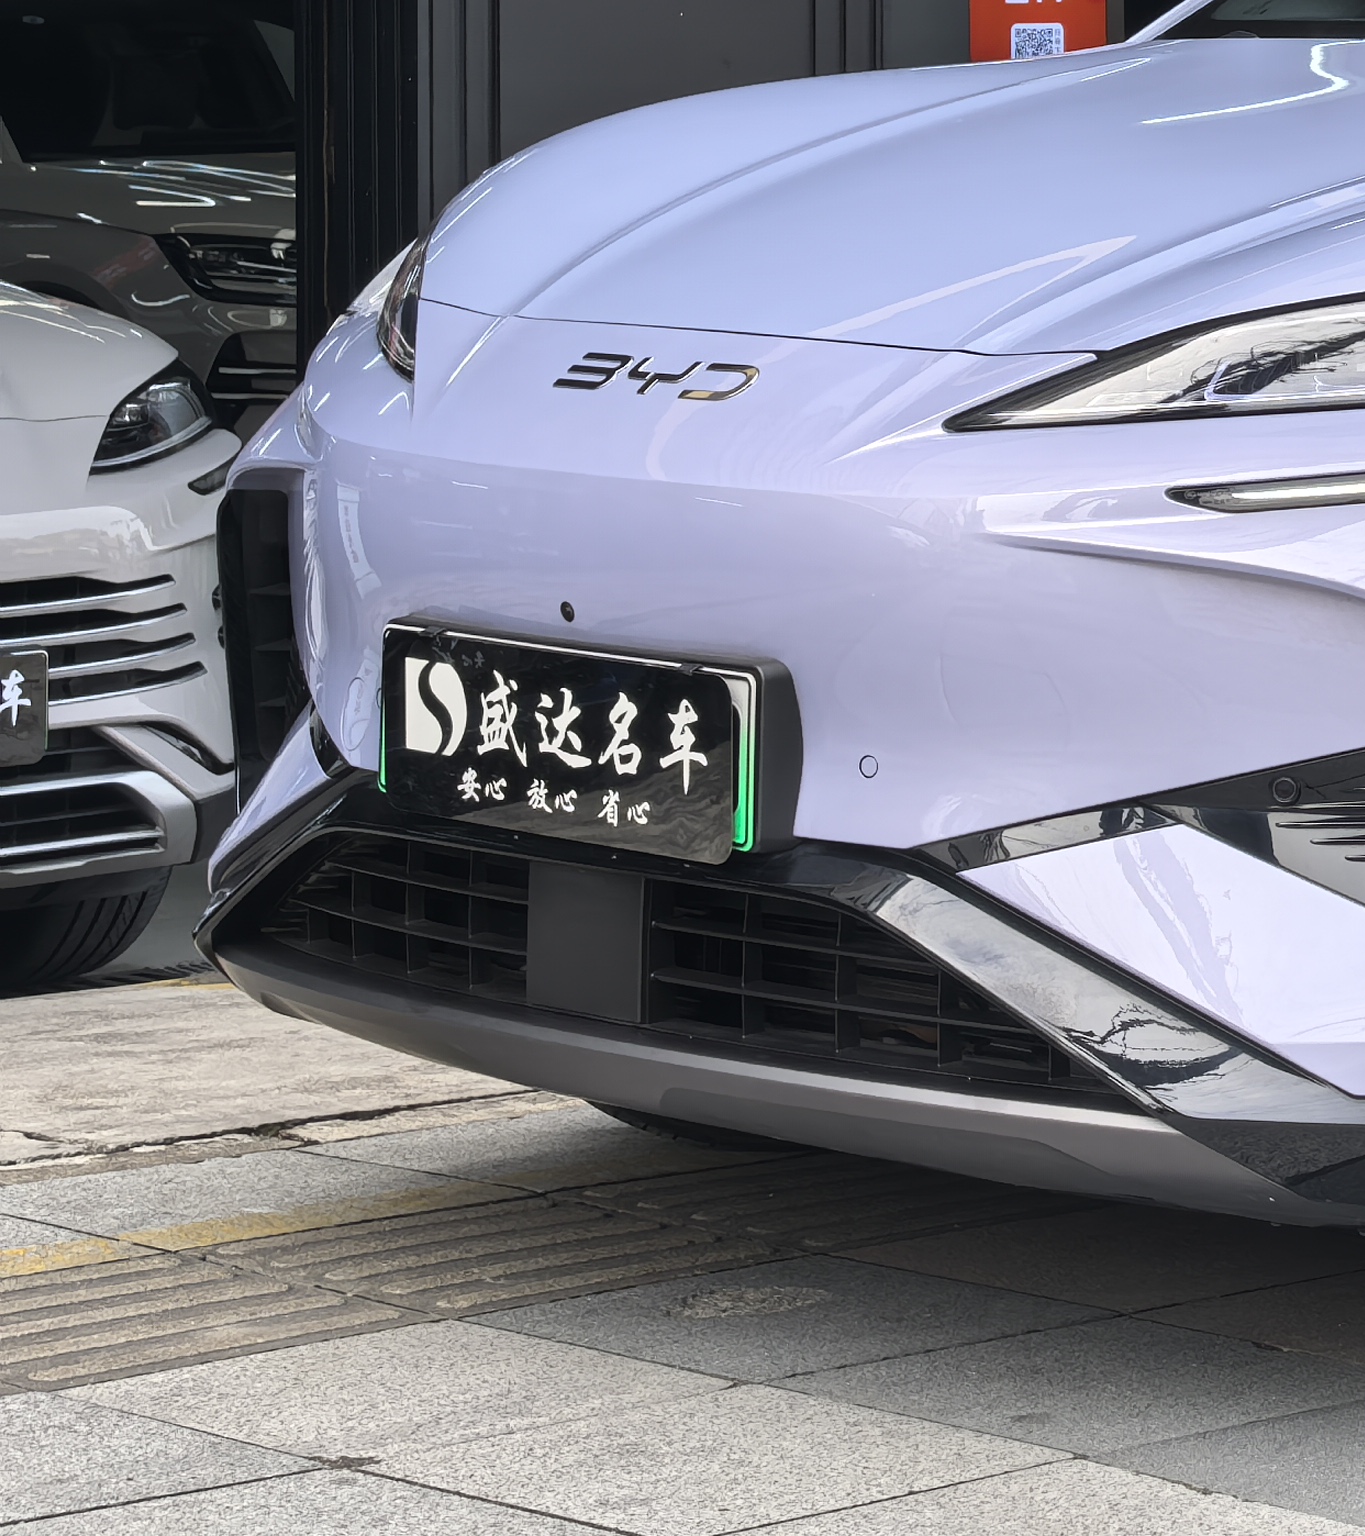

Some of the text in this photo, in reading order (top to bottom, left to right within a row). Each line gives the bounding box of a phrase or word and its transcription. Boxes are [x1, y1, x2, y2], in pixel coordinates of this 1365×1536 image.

[552, 351, 761, 402] BYD
[476, 668, 709, 796] 盛达名车
[457, 767, 650, 828] 安心 放心 省心
